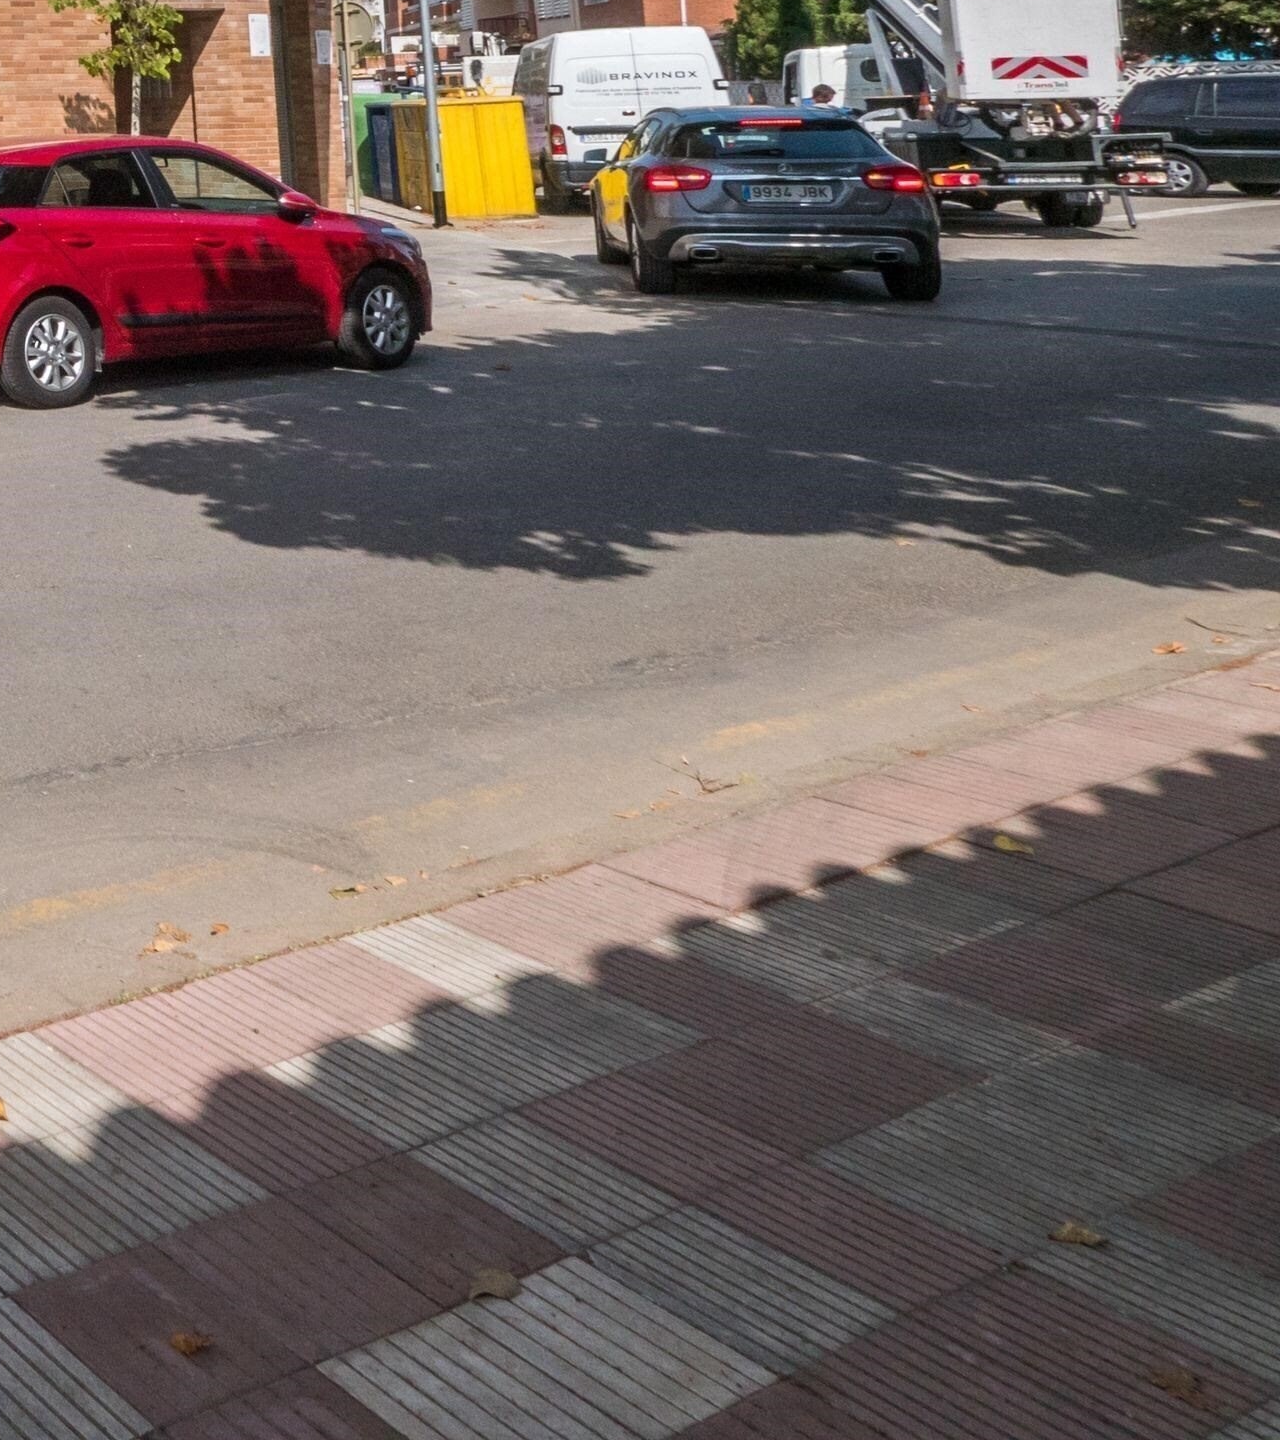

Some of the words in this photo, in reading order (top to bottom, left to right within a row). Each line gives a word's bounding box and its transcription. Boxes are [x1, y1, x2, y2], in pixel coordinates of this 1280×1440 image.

[609, 70, 698, 81] BRAVINOX
[752, 186, 793, 198] 9934
[799, 186, 829, 198] JBK
